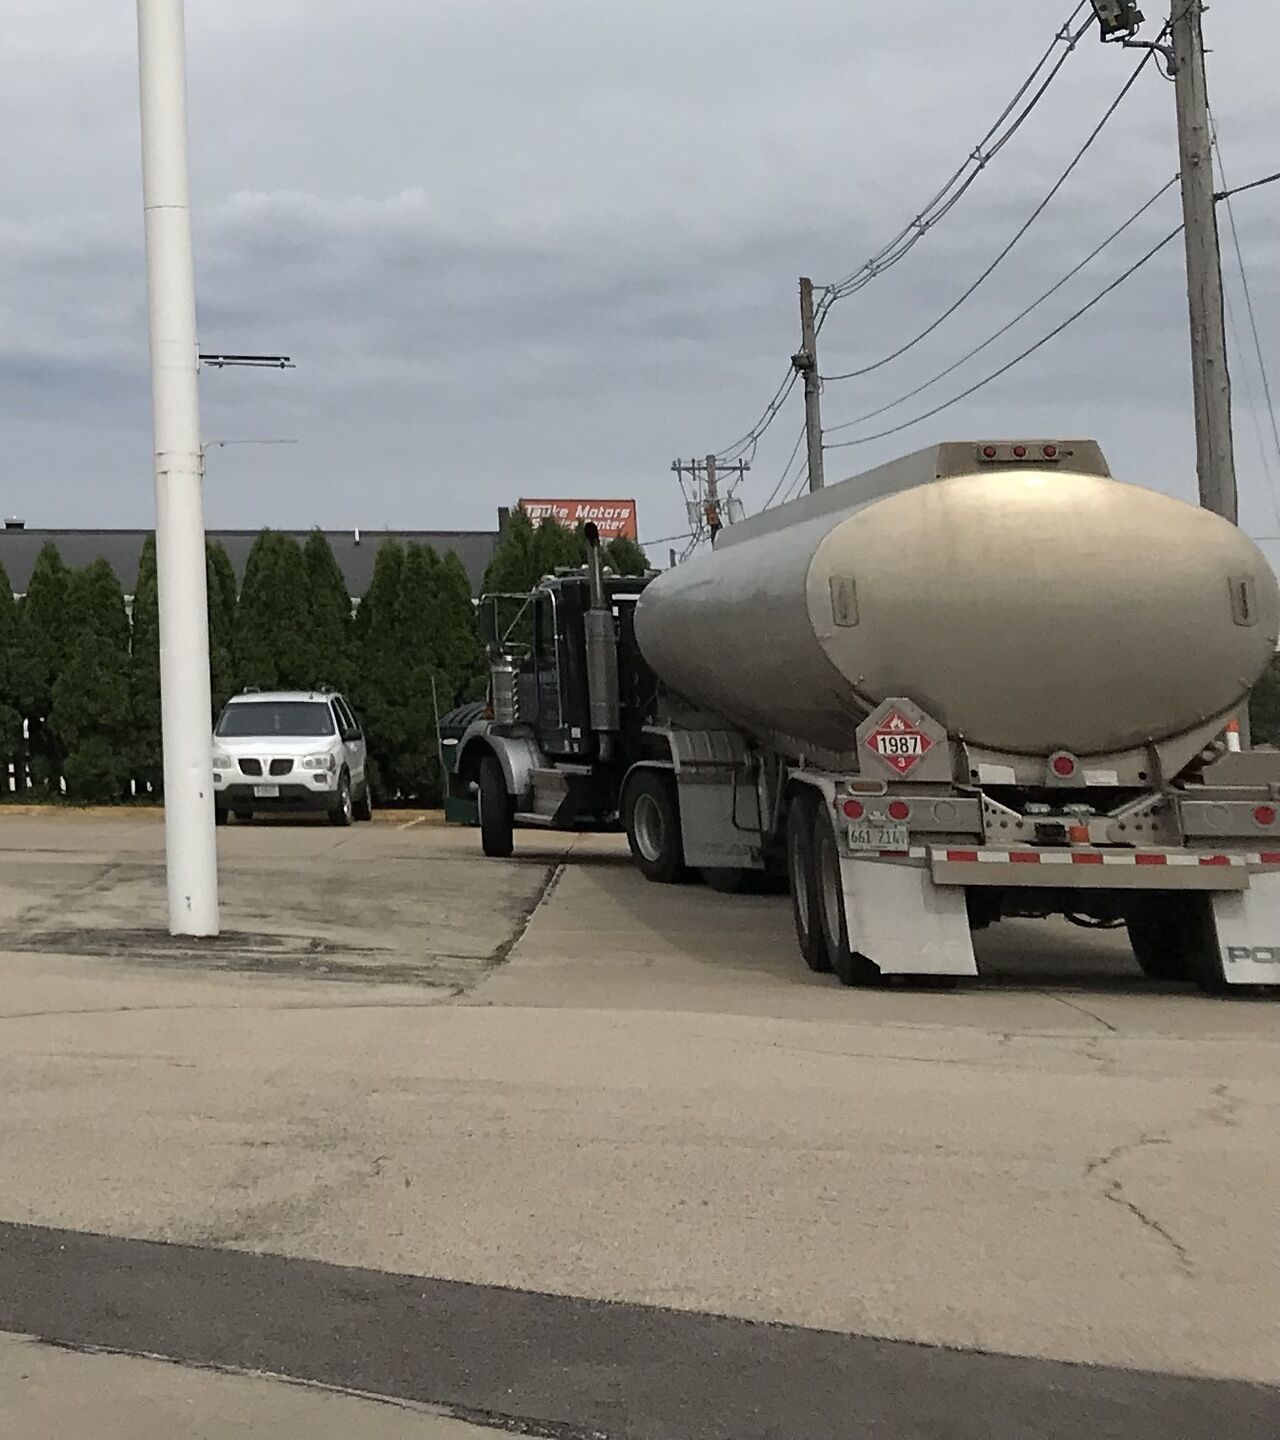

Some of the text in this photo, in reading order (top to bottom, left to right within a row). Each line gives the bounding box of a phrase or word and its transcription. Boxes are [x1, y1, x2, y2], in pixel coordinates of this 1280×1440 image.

[575, 504, 630, 518] Motors
[880, 736, 918, 754] 1987
[897, 757, 906, 768] 3
[1228, 946, 1280, 964] PO
